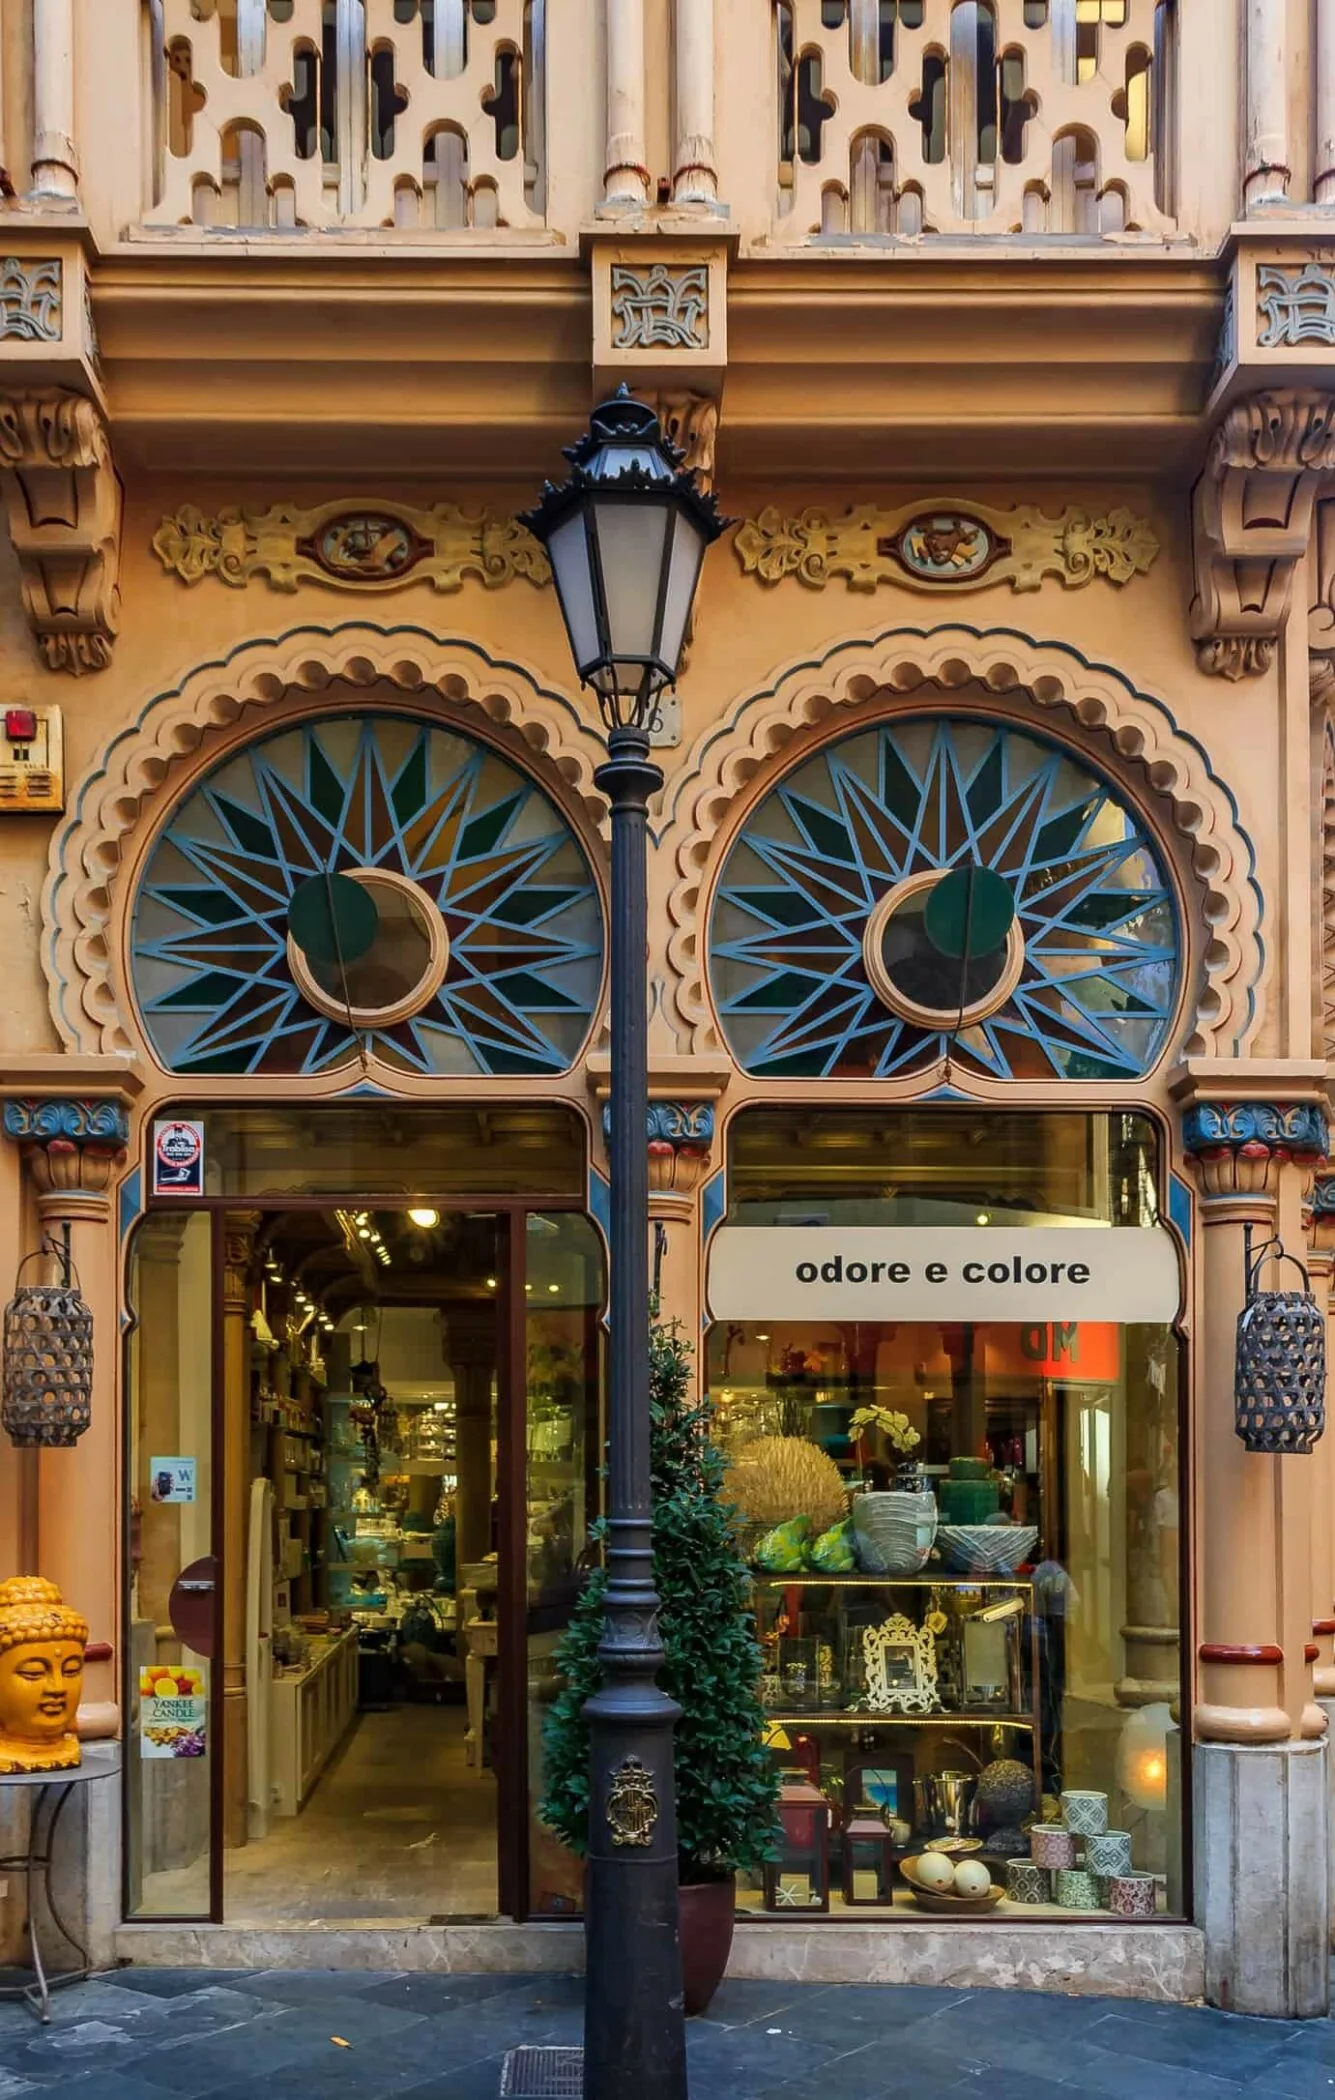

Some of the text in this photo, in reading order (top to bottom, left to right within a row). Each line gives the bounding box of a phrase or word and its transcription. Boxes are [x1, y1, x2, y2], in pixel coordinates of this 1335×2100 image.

[795, 1255, 1090, 1284] odore e colore
[153, 1700, 193, 1708] YANKEE
[152, 1709, 195, 1717] CANDLE
